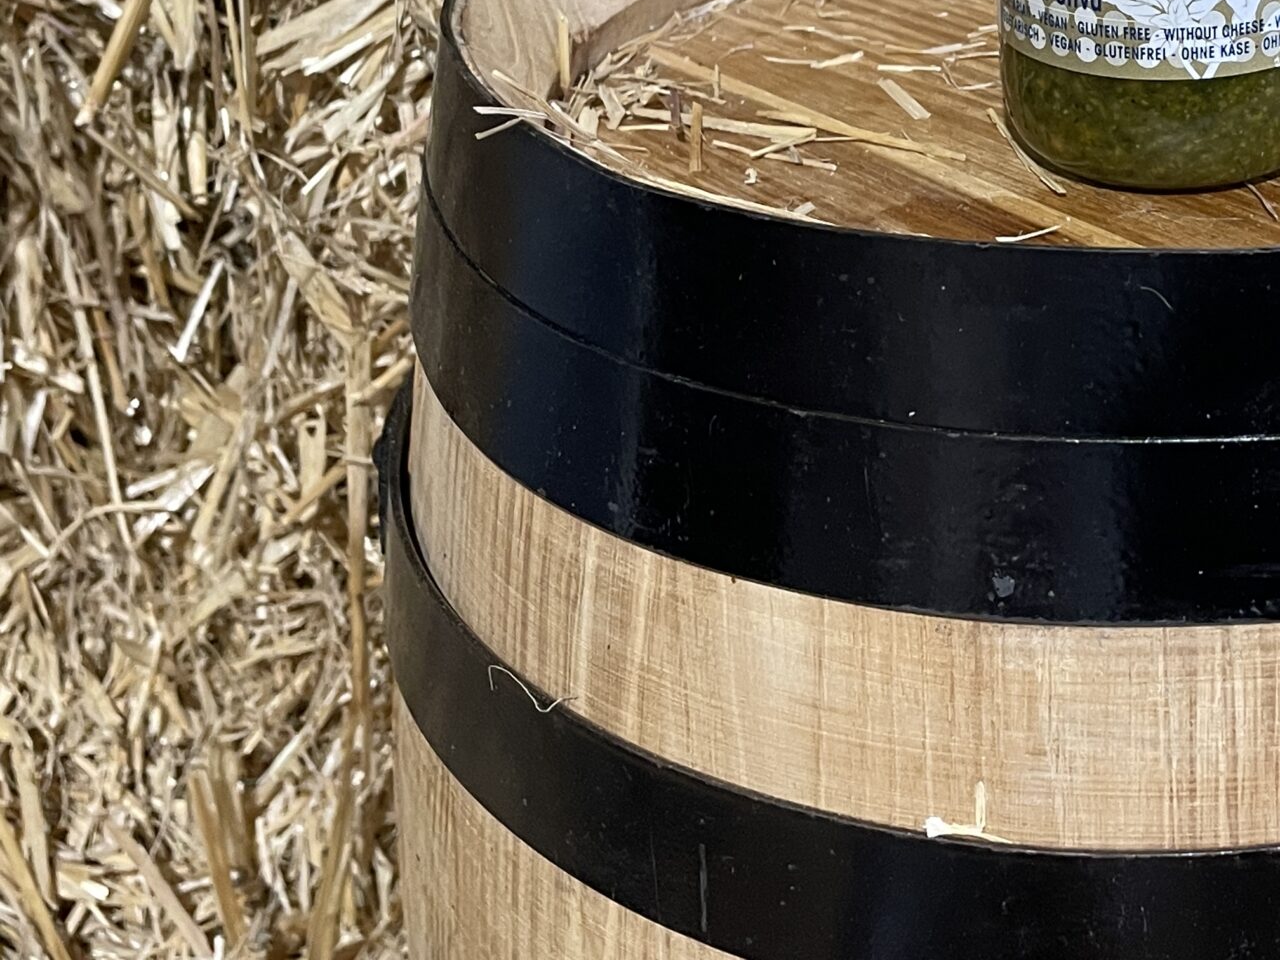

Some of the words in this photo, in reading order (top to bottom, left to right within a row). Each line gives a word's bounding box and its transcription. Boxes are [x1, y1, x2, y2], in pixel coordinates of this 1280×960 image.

[1038, 10, 1068, 30] VEGAN
[1077, 21, 1119, 39] GLUTEN
[1123, 26, 1151, 41] FREE
[1163, 25, 1218, 41] WITHOUT
[1222, 19, 1265, 38] CHEESE
[1050, 34, 1081, 53] VEGAN
[1094, 43, 1167, 60] GLUTENFREI
[1182, 45, 1215, 60] OHNE
